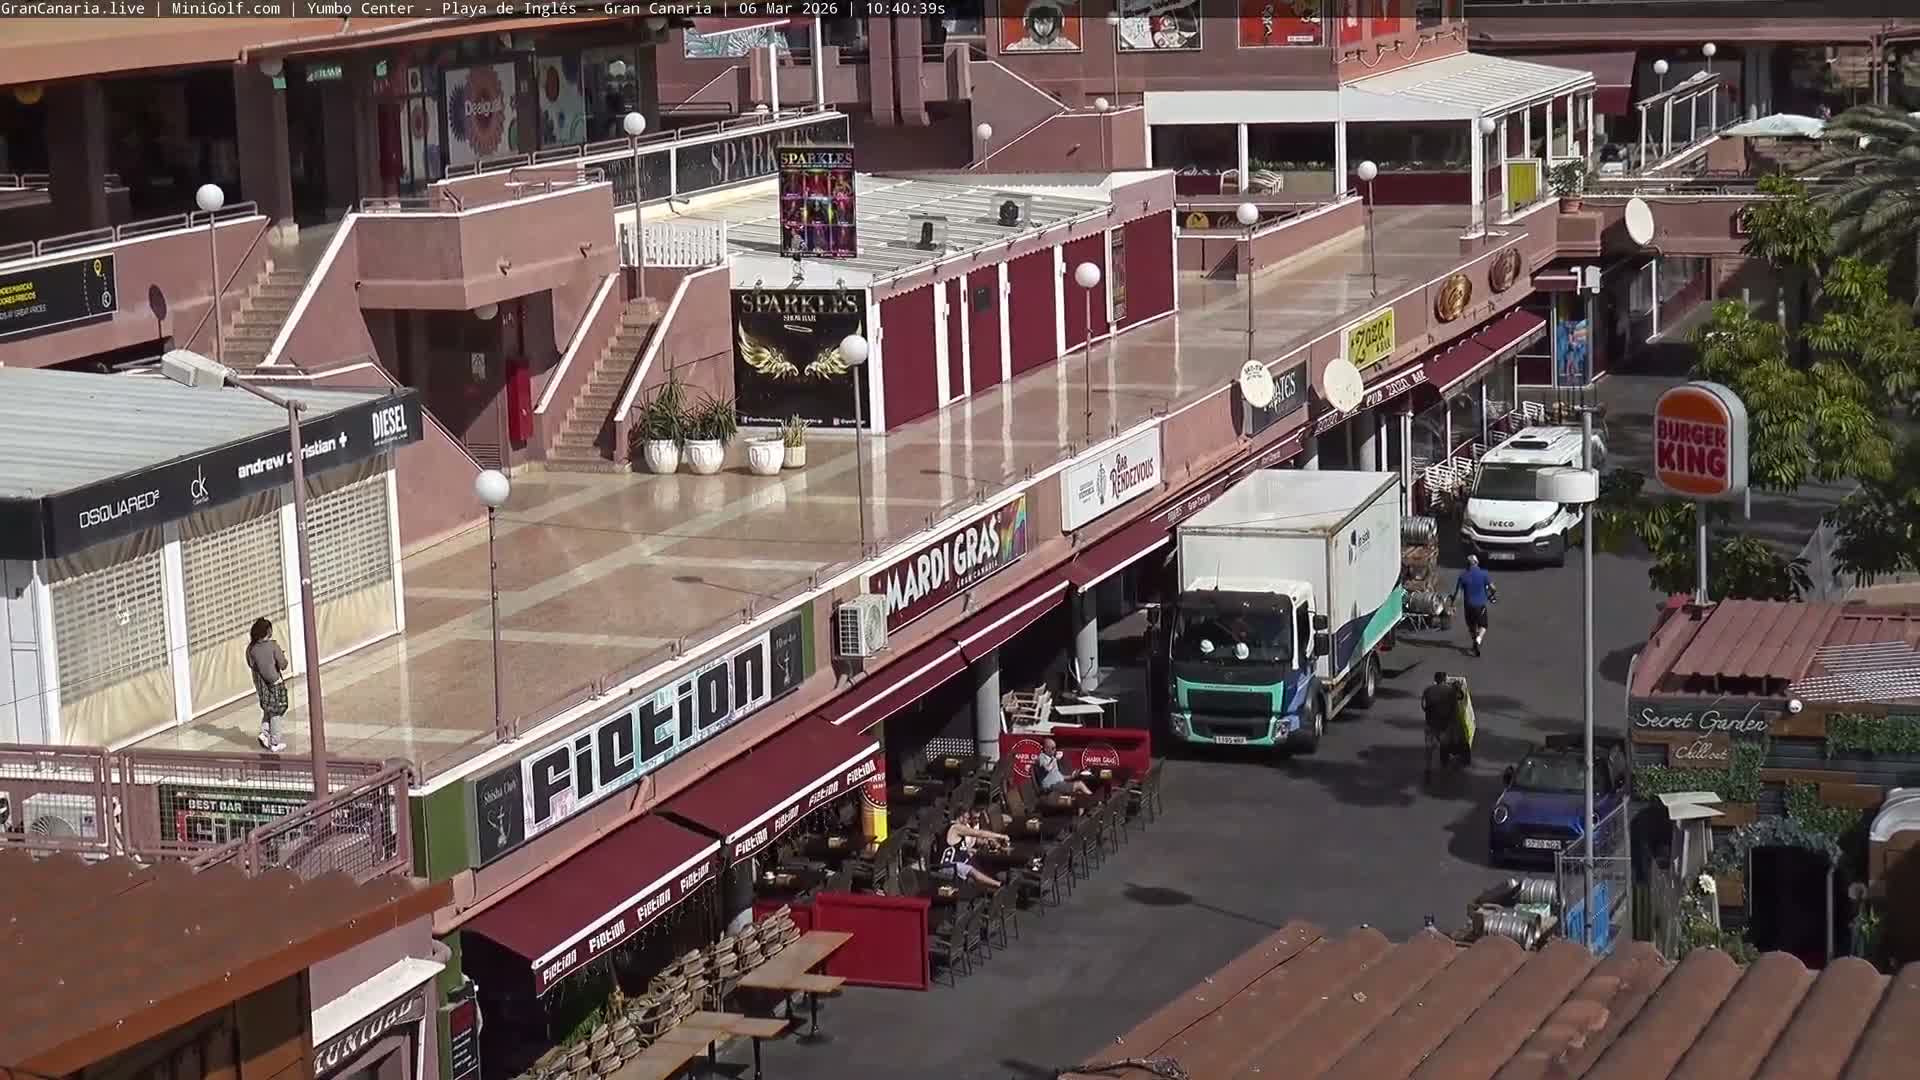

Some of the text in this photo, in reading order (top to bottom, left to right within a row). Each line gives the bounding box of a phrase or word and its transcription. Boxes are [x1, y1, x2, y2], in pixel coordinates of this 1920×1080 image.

[780, 152, 854, 165] SPARKLES
[740, 293, 859, 314] SPARKLES
[1366, 393, 1384, 408] PUB
[372, 404, 407, 440] DIESEL
[1658, 418, 1726, 448] BURGER
[238, 439, 336, 479] andrew cristian
[1658, 440, 1726, 478] KING
[885, 514, 1000, 616] MARDI GRAS
[1636, 695, 1768, 739] Secret Garden
[188, 799, 216, 811] BEST
[219, 801, 242, 812] BAR
[262, 803, 298, 815] MEETI
